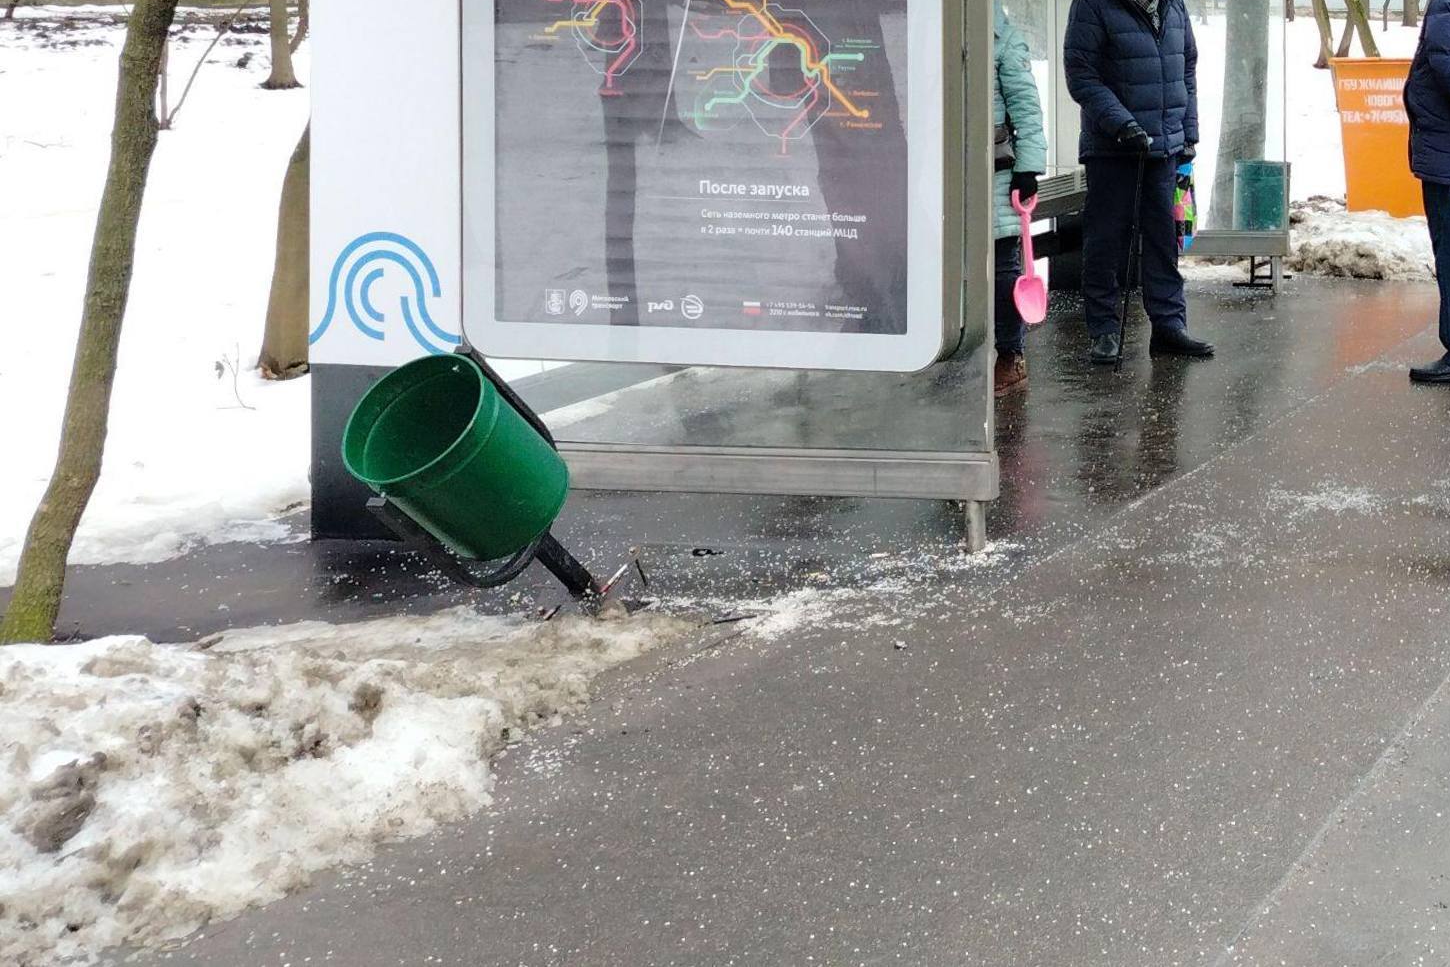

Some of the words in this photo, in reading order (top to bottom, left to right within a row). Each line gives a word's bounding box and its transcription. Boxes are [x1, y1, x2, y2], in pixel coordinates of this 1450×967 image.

[699, 180, 746, 195] После
[750, 184, 810, 199] запуска
[701, 209, 722, 218] Сеть
[723, 211, 770, 221] наземного
[771, 212, 800, 223] метро
[801, 214, 830, 222] станет
[832, 212, 867, 222] больше
[708, 225, 714, 233] 2
[715, 226, 736, 236] раза
[744, 227, 770, 236] почти
[771, 224, 793, 237] 140
[794, 227, 831, 239] станций
[832, 228, 858, 239] МЦД
